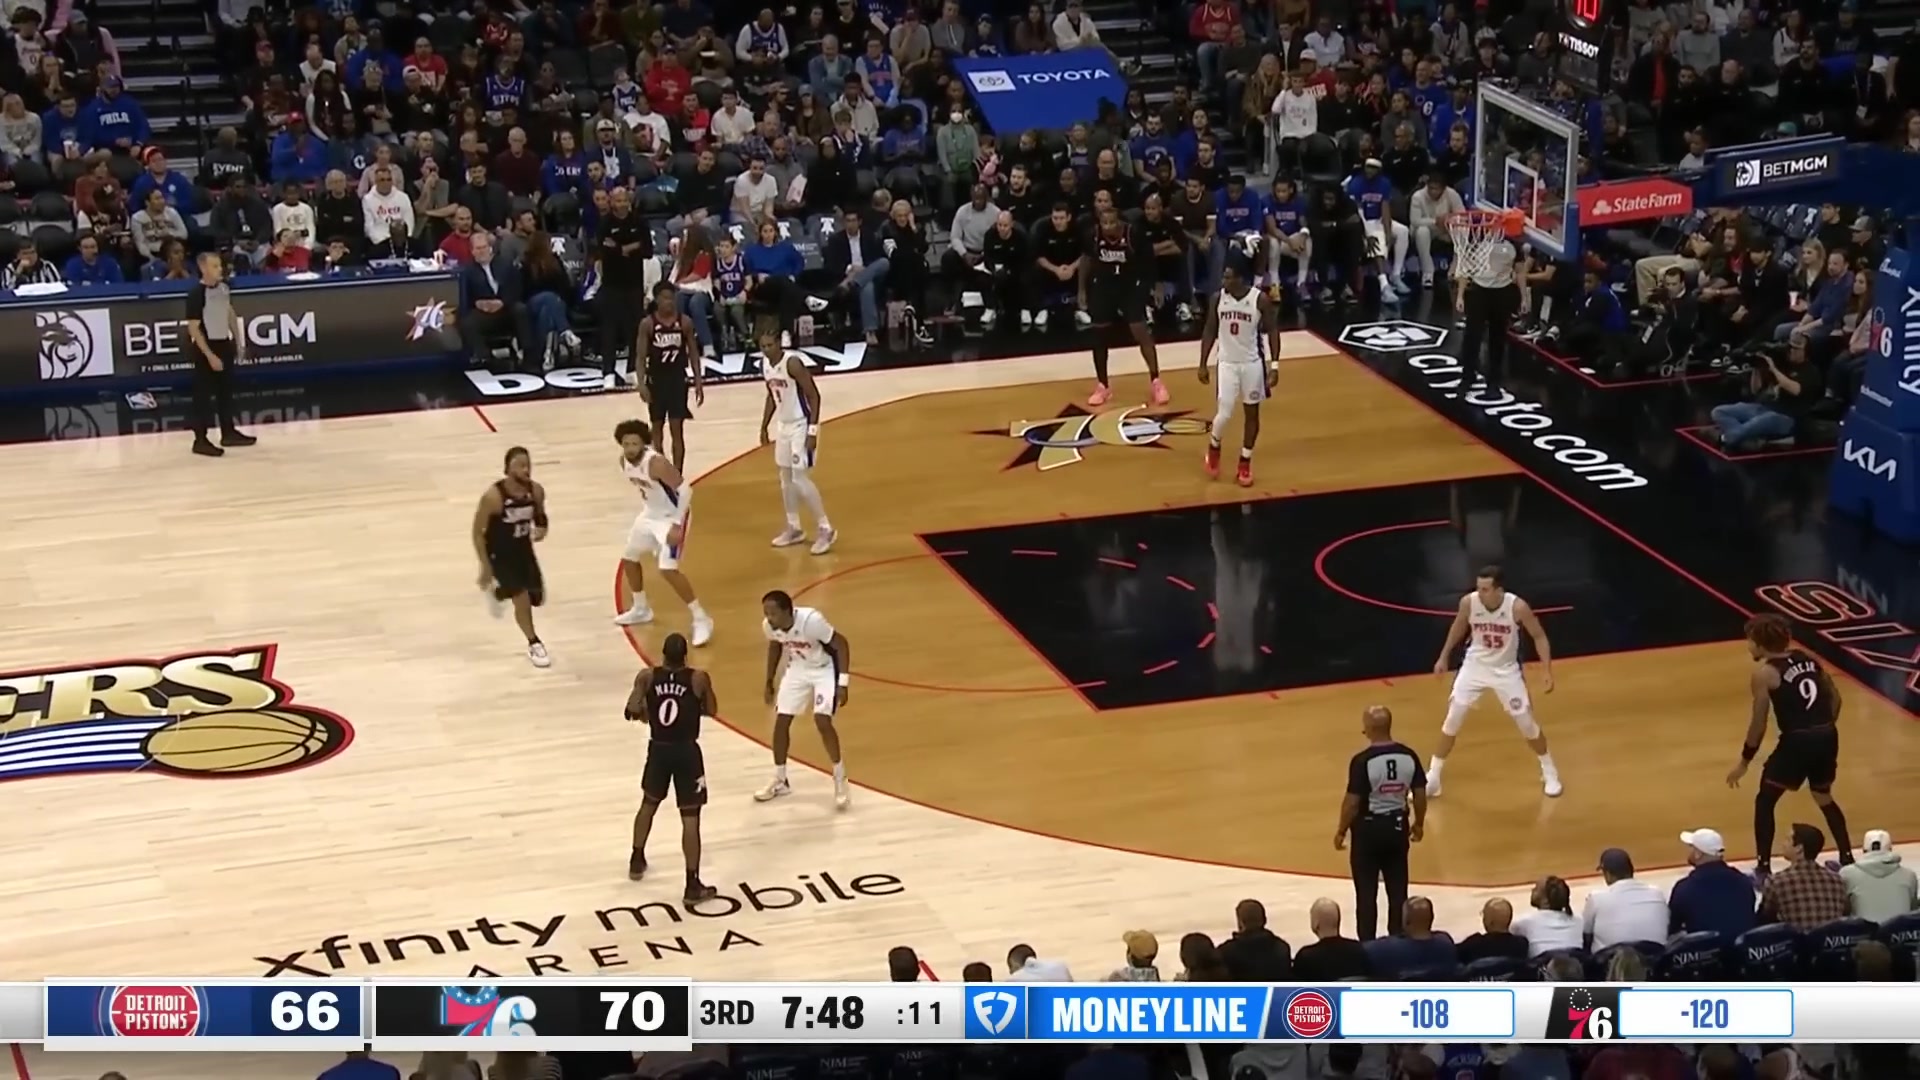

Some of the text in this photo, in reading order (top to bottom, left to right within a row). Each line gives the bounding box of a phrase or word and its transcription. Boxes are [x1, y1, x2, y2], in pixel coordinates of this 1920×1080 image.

[1017, 68, 1111, 85] TOYOTA
[212, 163, 244, 175] EVENT
[1762, 154, 1828, 178] BETMGM
[1220, 310, 1252, 323] PISTONS
[1229, 323, 1240, 336] 0
[661, 350, 679, 363] 77
[1473, 623, 1512, 635] PISTONS
[1481, 635, 1505, 650] 55
[655, 683, 687, 697] MAXEY
[1798, 677, 1818, 711] 9
[658, 698, 678, 727] 0
[1385, 758, 1398, 781] 8
[254, 870, 906, 980] xfinity mobile
[1747, 945, 1776, 962] NJM
